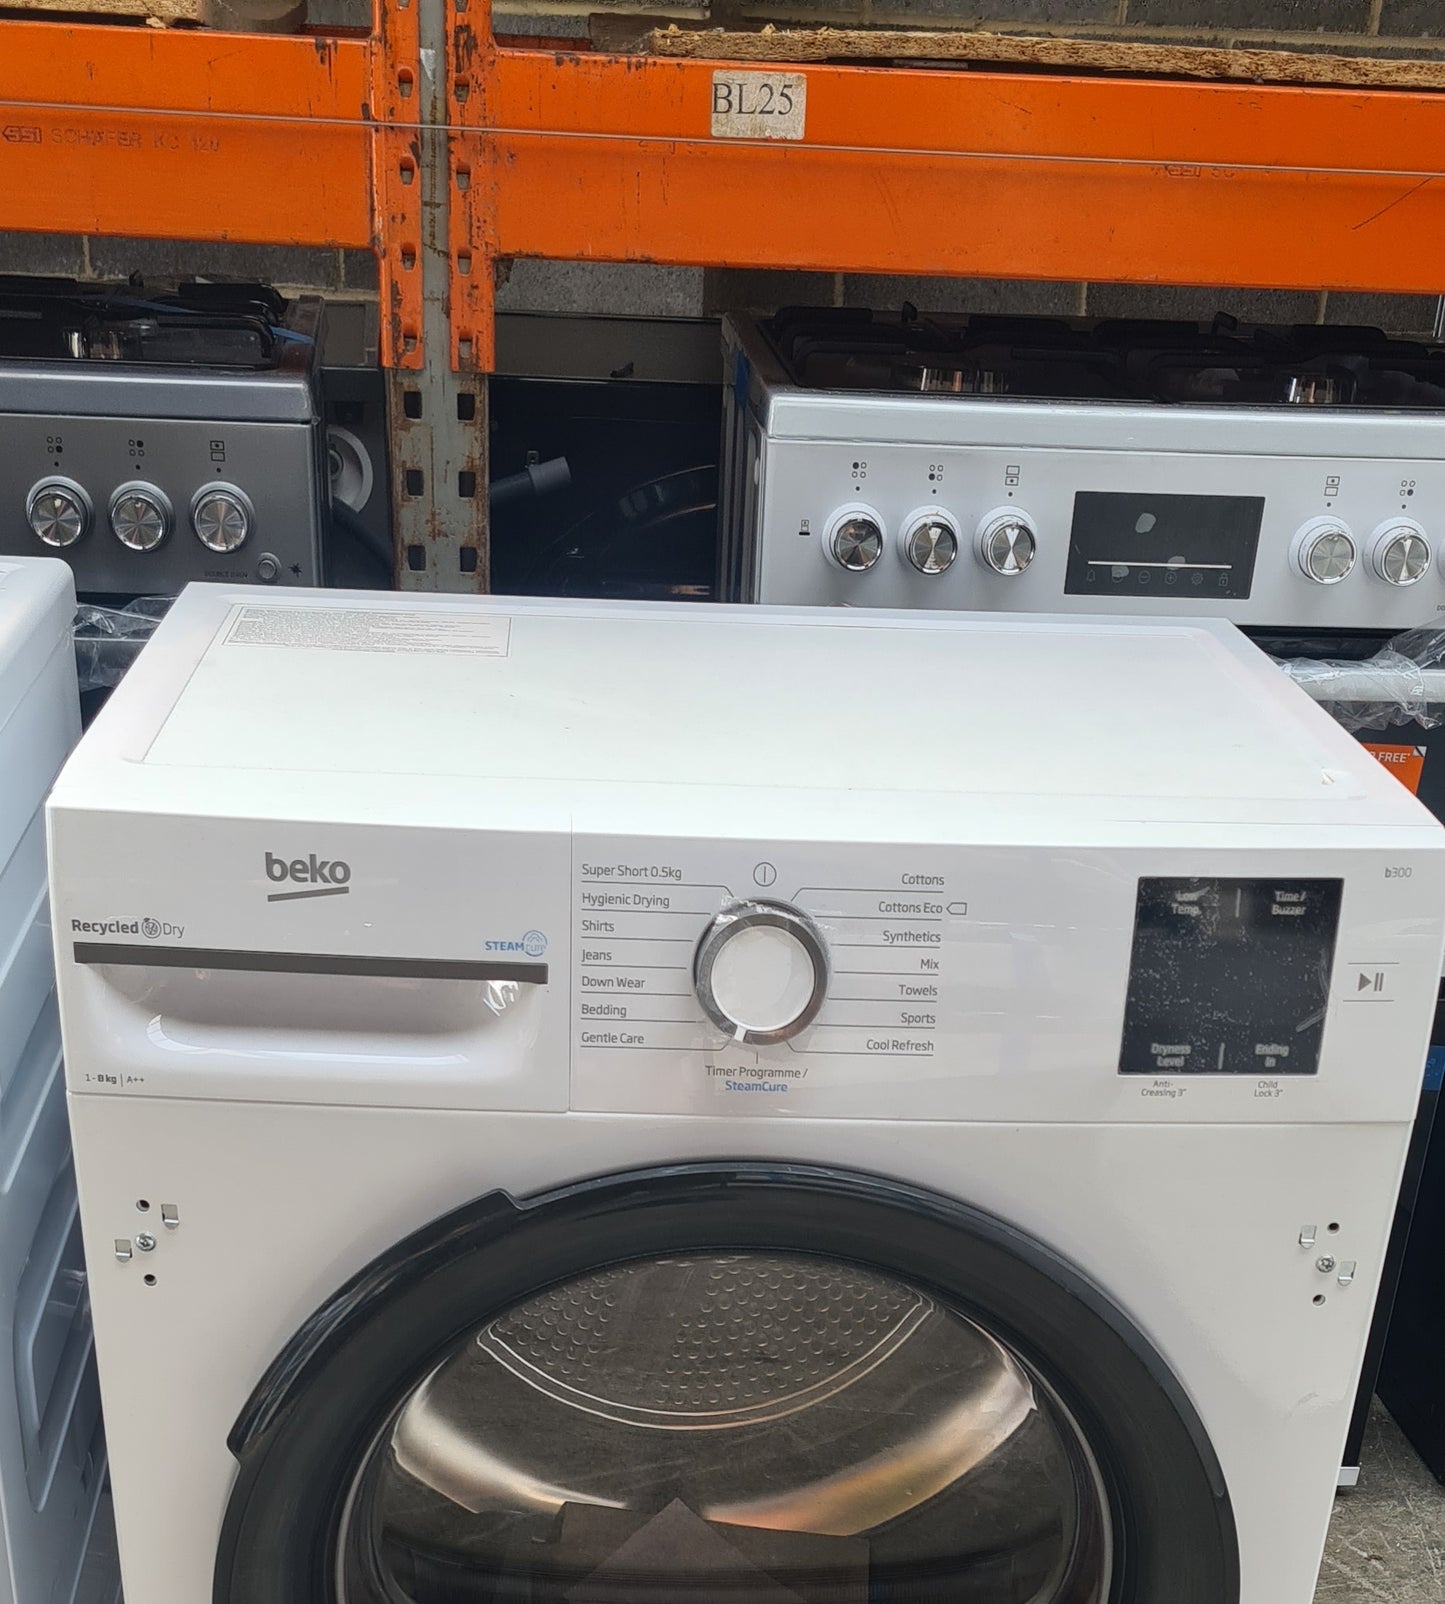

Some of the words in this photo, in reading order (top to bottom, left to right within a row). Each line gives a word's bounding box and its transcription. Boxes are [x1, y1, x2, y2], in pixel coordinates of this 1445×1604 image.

[712, 82, 794, 115] BL25
[265, 852, 351, 884] beko
[582, 864, 615, 877] Super
[617, 865, 648, 877] Short
[650, 866, 682, 880] 0.5kg
[901, 873, 945, 885] Cottons
[582, 893, 631, 907] Hygienic
[633, 895, 670, 908] Drying
[878, 901, 921, 913] Cottons
[924, 903, 943, 914] Eco
[1271, 904, 1307, 916] Buzzer
[71, 919, 140, 936] Recycled
[162, 922, 185, 938] Dry
[582, 919, 614, 932] Shirts
[883, 930, 941, 944] Synthetics
[485, 940, 525, 951] STEAM
[582, 949, 612, 962] Jeans
[920, 959, 939, 970] Mix
[582, 976, 613, 988] Down
[616, 978, 645, 989] Wear
[899, 985, 937, 996] Towels
[582, 1004, 627, 1017] Bedding
[901, 1012, 935, 1026] Sports
[582, 1032, 617, 1044] Gentle
[620, 1034, 644, 1044] Care
[867, 1039, 890, 1051] Cool
[893, 1040, 934, 1052] Refresh
[1151, 1042, 1192, 1056] Dryness
[706, 1066, 737, 1078] Timer
[740, 1067, 800, 1080] Programme
[725, 1081, 788, 1092] SteamCure
[1257, 1080, 1278, 1089] Child
[1141, 1088, 1176, 1098] Creasing
[1253, 1089, 1272, 1098] Lock
